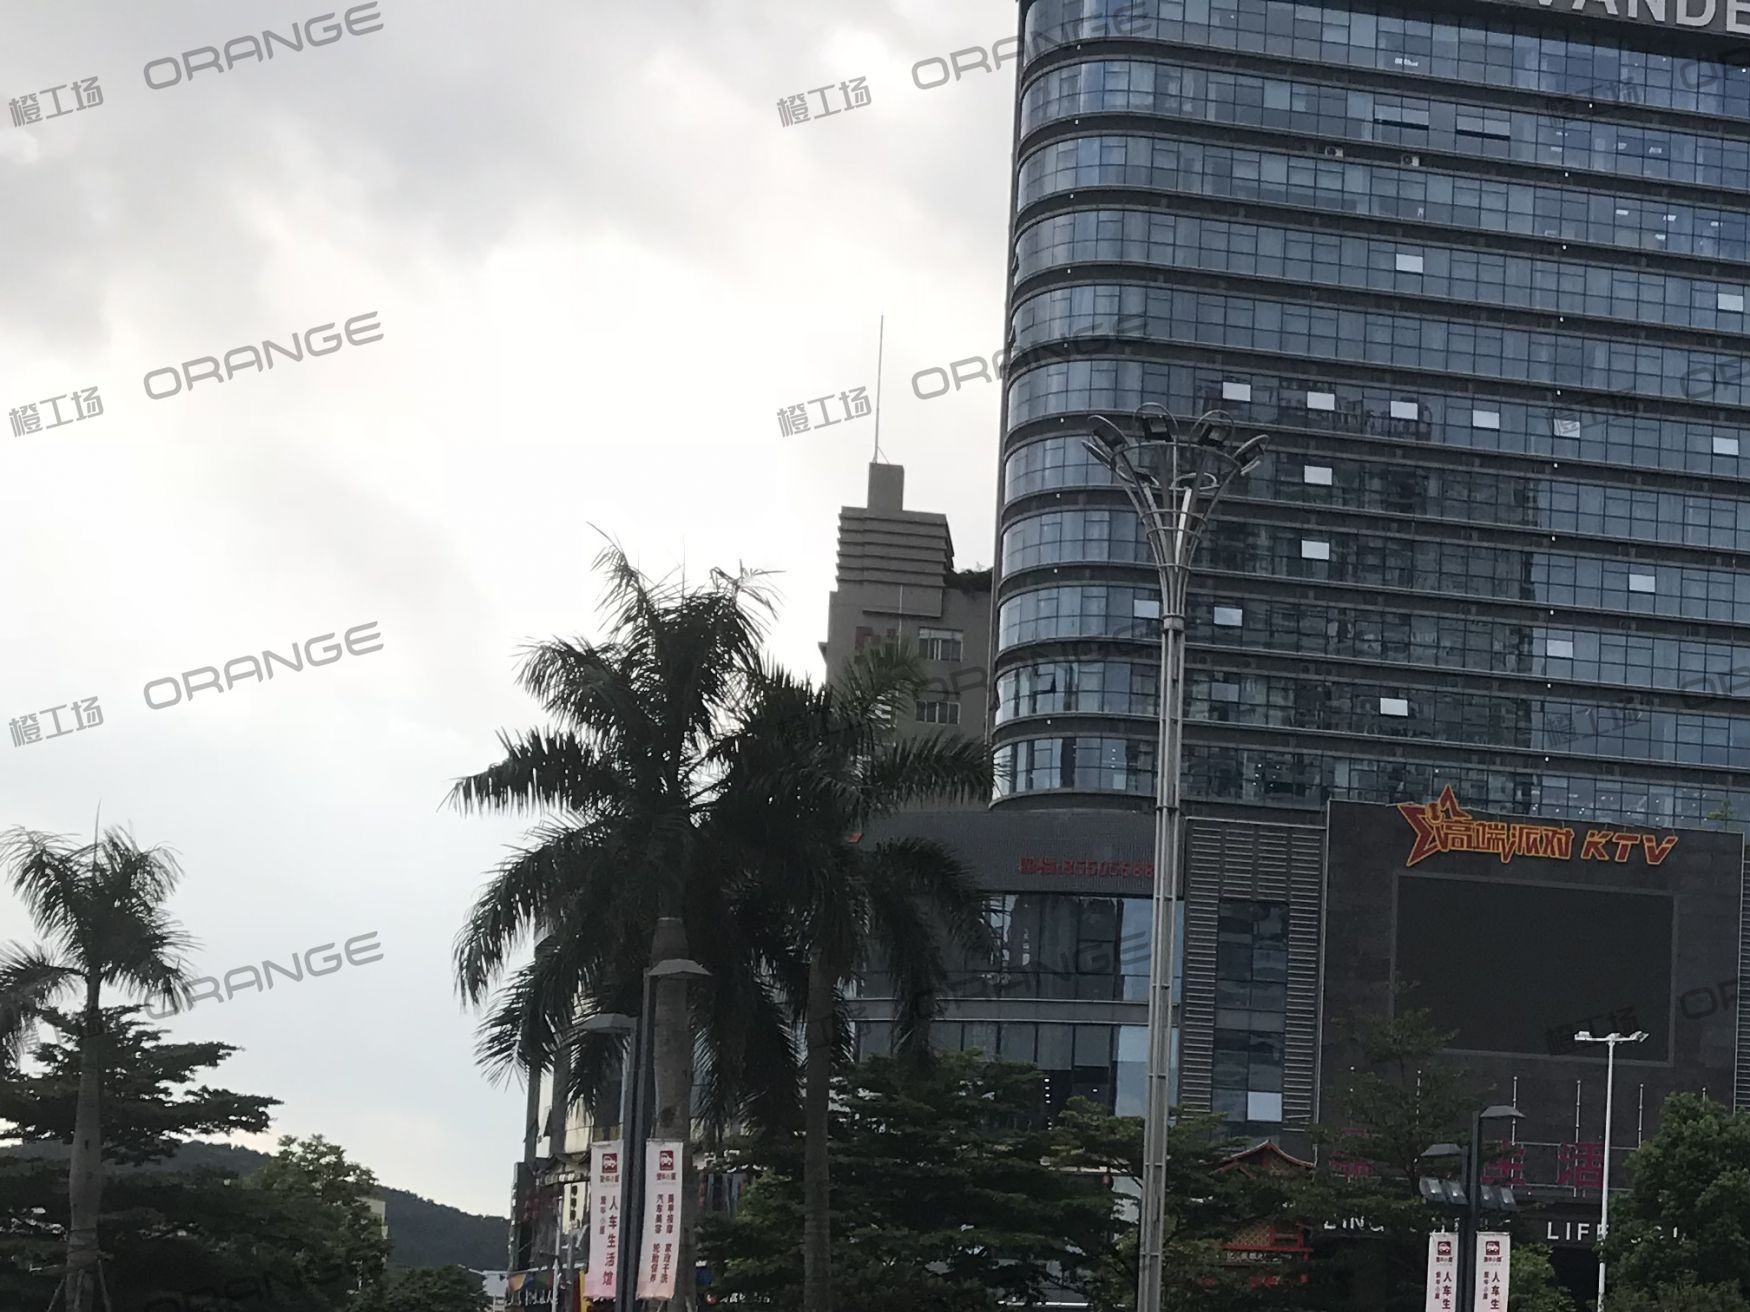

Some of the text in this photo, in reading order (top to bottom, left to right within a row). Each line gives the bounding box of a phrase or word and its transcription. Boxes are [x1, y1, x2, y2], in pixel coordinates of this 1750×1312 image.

[1581, 830, 1678, 866] KTV
[602, 1195, 619, 1286] 人车生活馆
